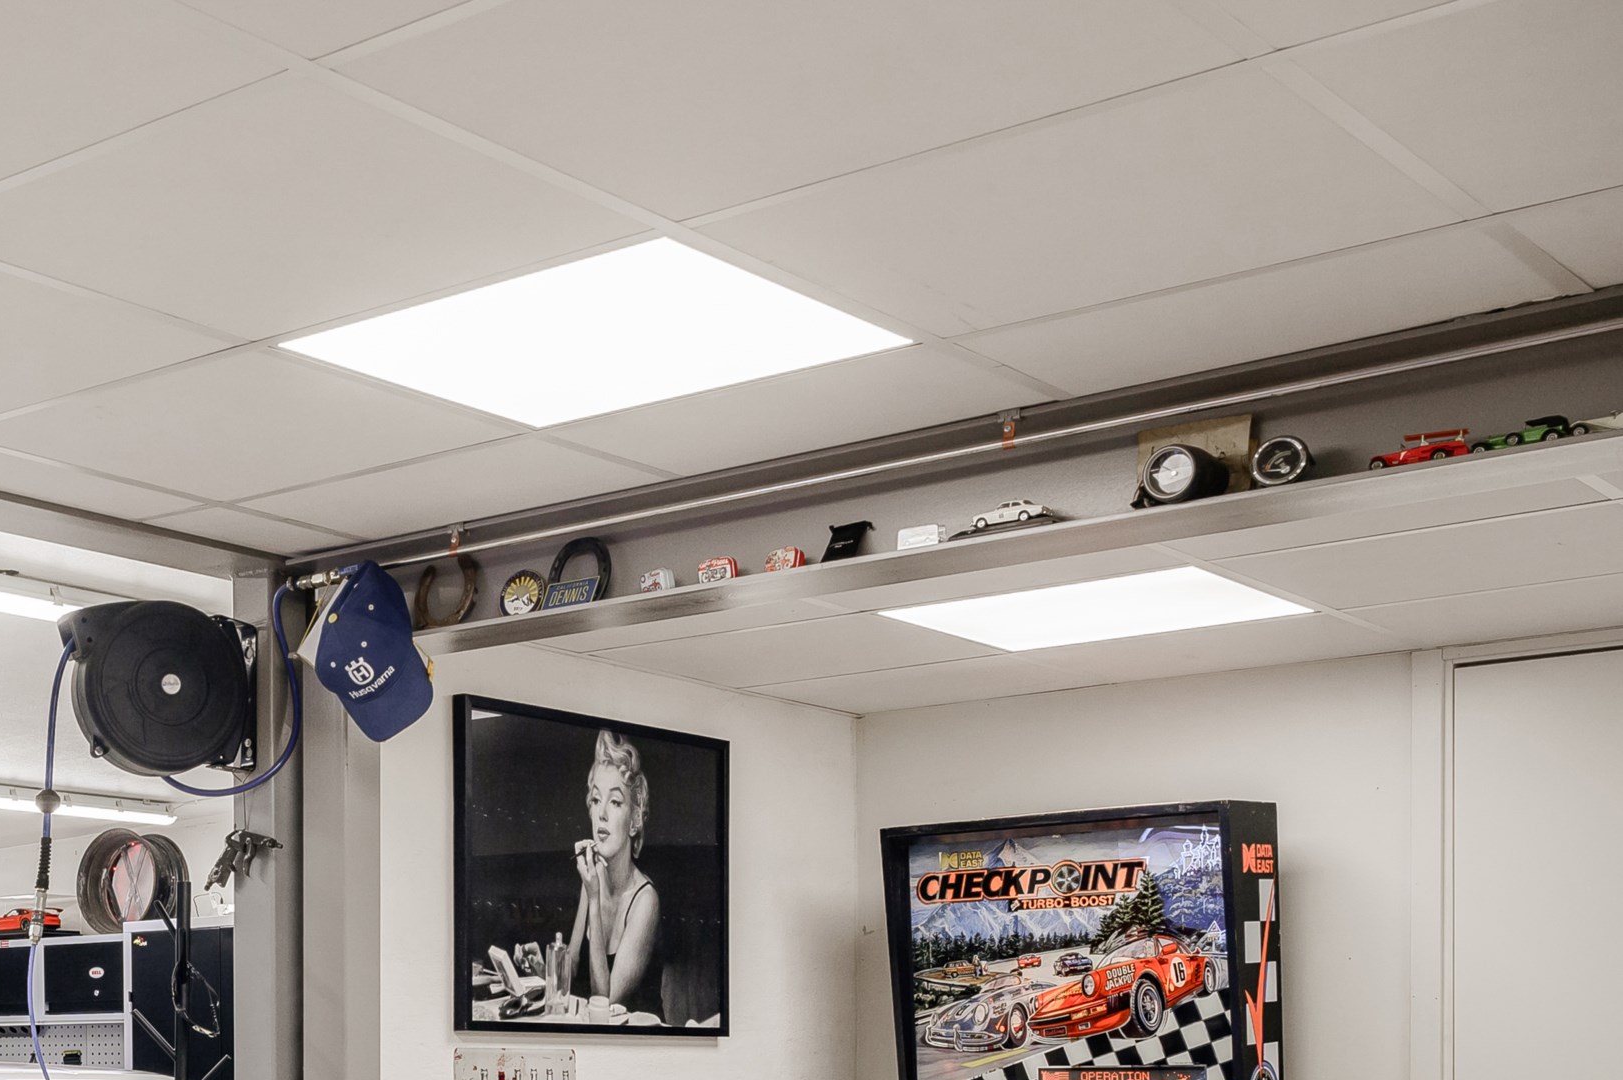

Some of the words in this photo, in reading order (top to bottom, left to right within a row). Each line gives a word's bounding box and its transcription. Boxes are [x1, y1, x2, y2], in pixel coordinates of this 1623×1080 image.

[557, 581, 589, 590] CALIFORNIA
[549, 586, 589, 607] DENNIS
[348, 665, 395, 699] Husqvarna
[960, 852, 983, 860] DATA
[1257, 844, 1273, 858] DATA
[960, 859, 984, 868] EAST
[1257, 860, 1274, 873] EAST
[1022, 895, 1114, 910] TURBO-BOOST
[1106, 964, 1136, 979] DOUBLE
[1174, 962, 1185, 984] 16
[1105, 973, 1135, 991] JACKPOT
